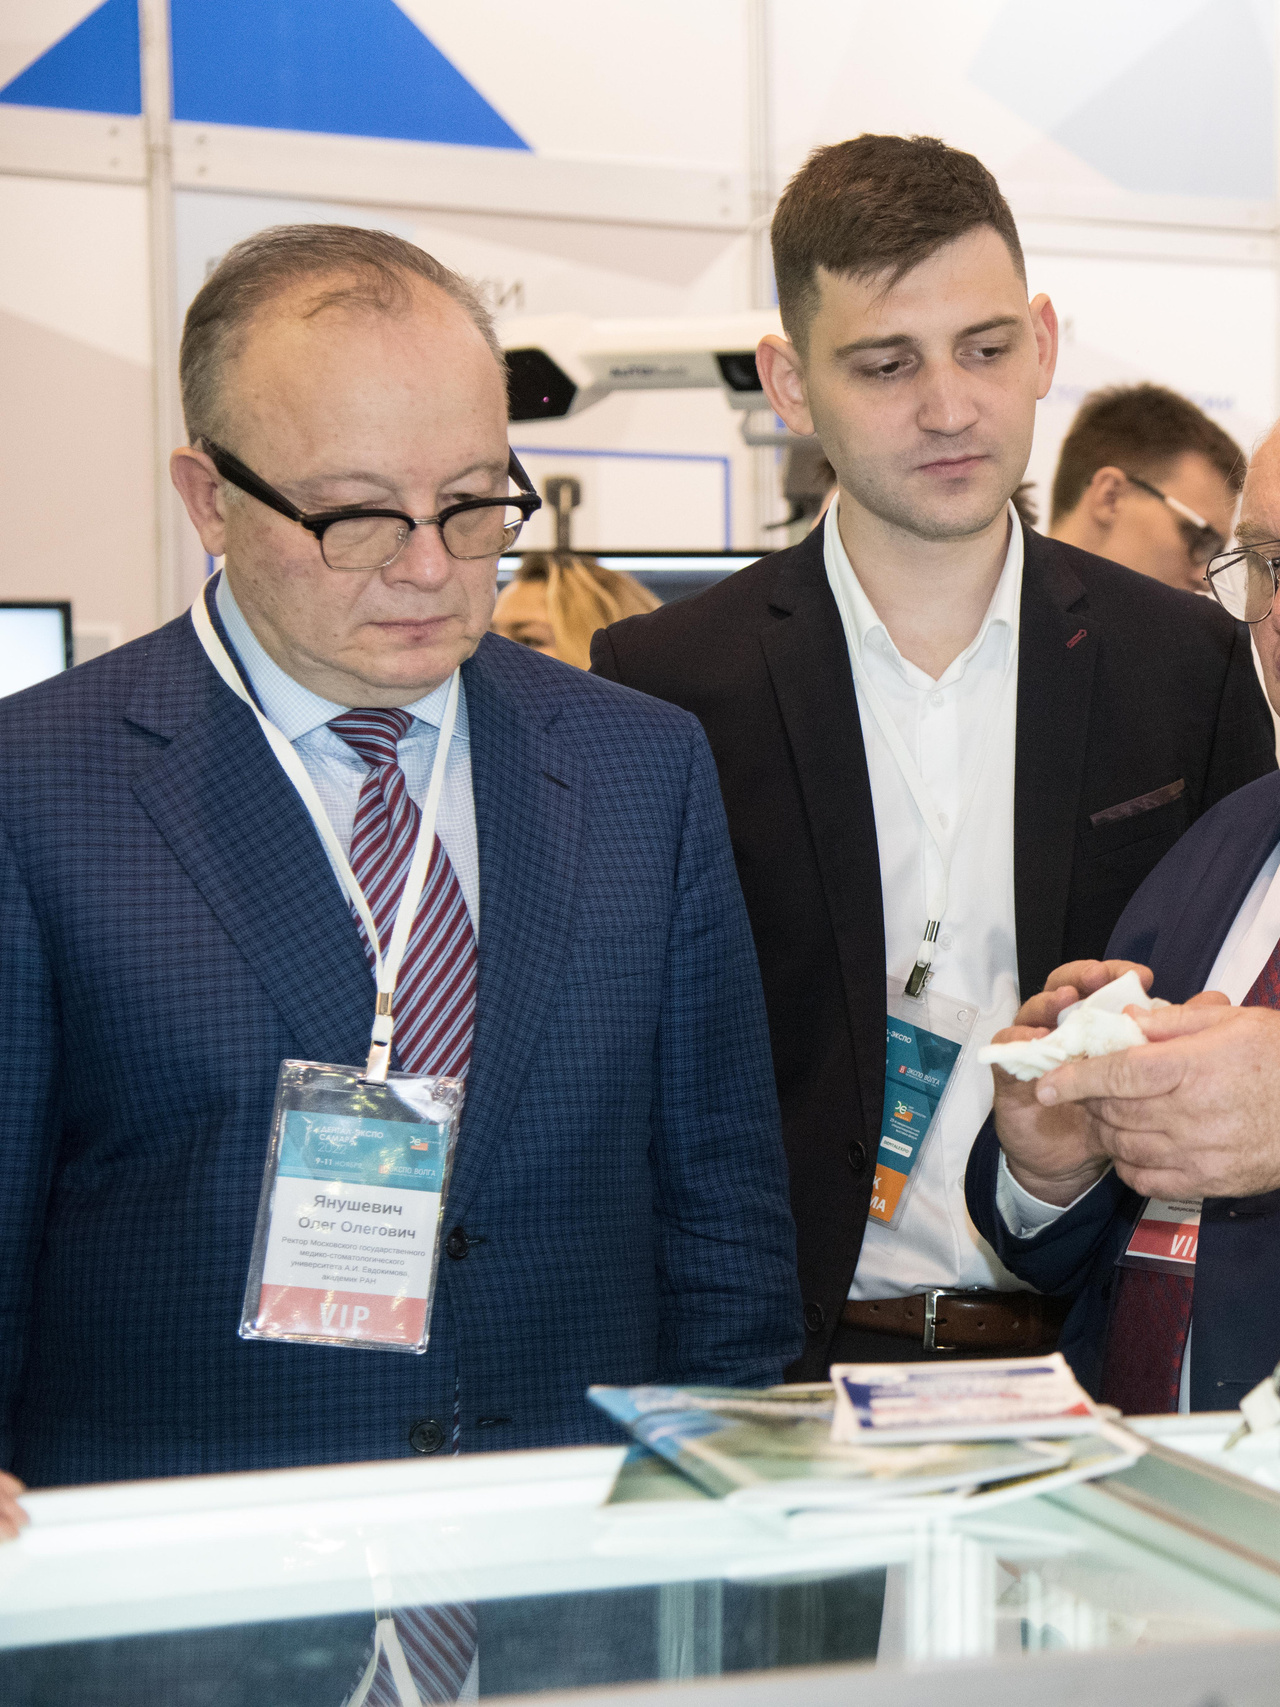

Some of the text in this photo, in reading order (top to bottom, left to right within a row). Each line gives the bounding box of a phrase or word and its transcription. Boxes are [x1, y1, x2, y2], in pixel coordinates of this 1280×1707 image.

[317, 1141, 347, 1155] 2022
[315, 1157, 333, 1166] 9-11
[313, 1194, 403, 1216] Янушевич
[298, 1216, 416, 1239] Олег Олегович
[281, 1236, 426, 1257] Ректор Московского государственного
[299, 1250, 405, 1265] медико-стоматологического
[290, 1260, 342, 1273] университета
[359, 1276, 377, 1285] РАН
[319, 1303, 370, 1329] VIP
